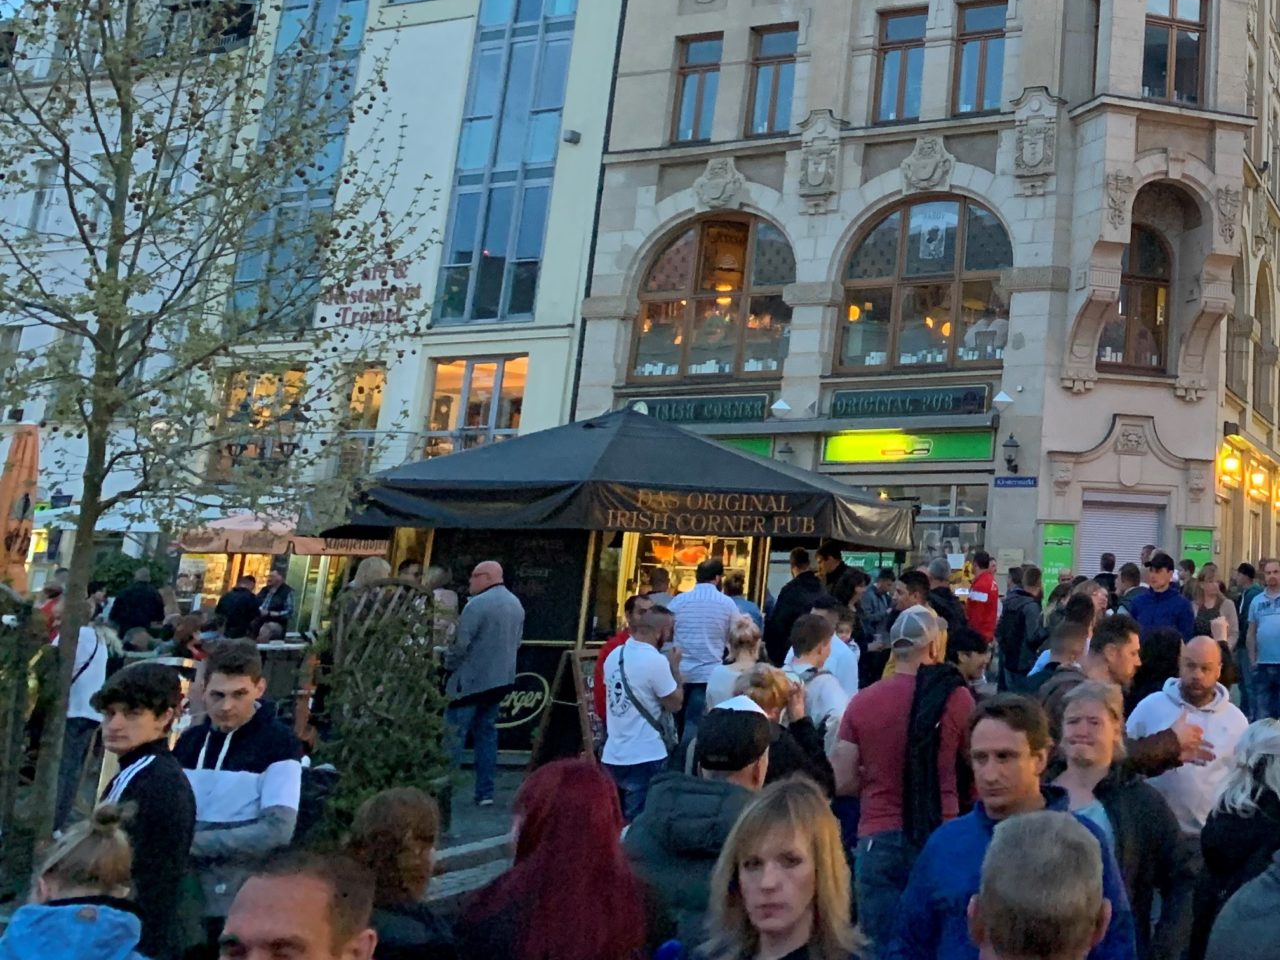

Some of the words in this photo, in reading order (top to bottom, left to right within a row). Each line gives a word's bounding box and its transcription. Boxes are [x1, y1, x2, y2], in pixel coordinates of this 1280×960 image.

[637, 490, 680, 509] DAS
[687, 492, 792, 512] ORIGINAL
[607, 509, 670, 530] IRISH
[675, 513, 766, 533] CORNER
[772, 516, 815, 533] PUB
